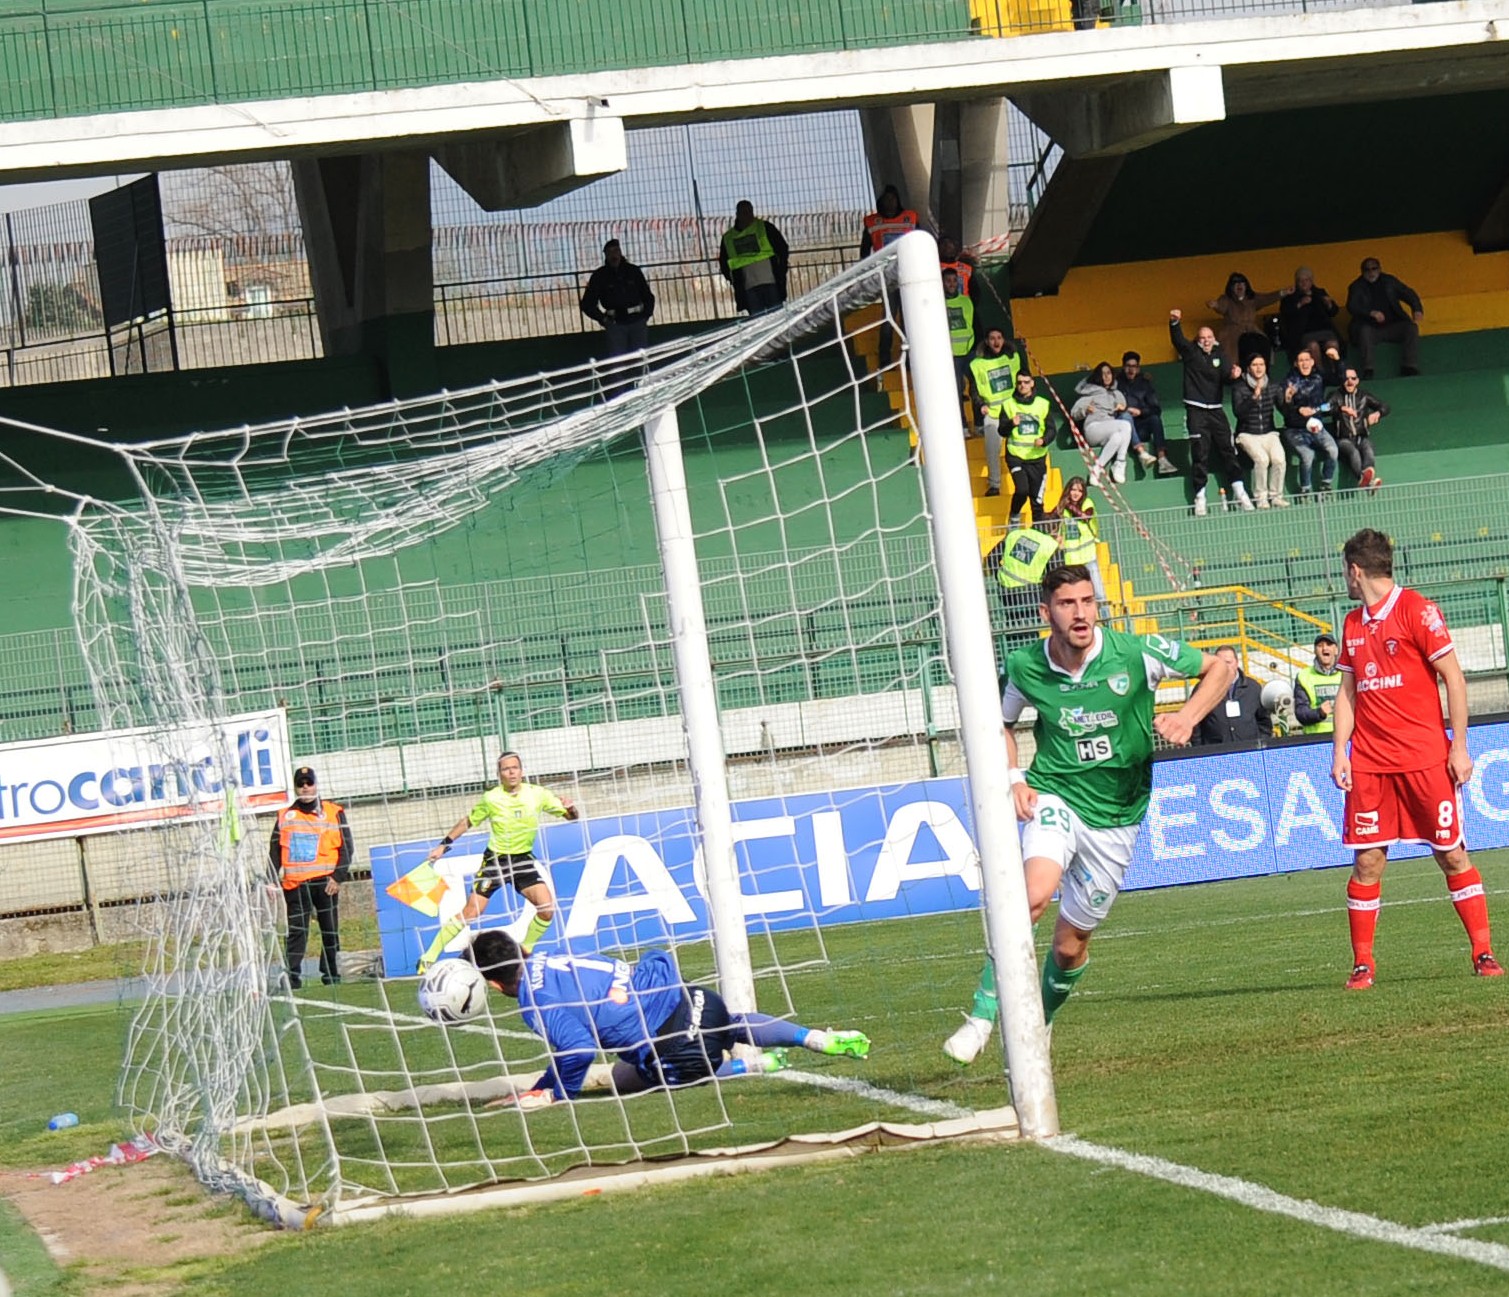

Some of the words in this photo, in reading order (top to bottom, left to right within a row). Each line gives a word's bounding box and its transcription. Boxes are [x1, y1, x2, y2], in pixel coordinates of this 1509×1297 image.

[1079, 741, 1109, 760] HS
[1039, 806, 1071, 833] 29
[1438, 800, 1454, 828] 8
[546, 956, 614, 973] 1
